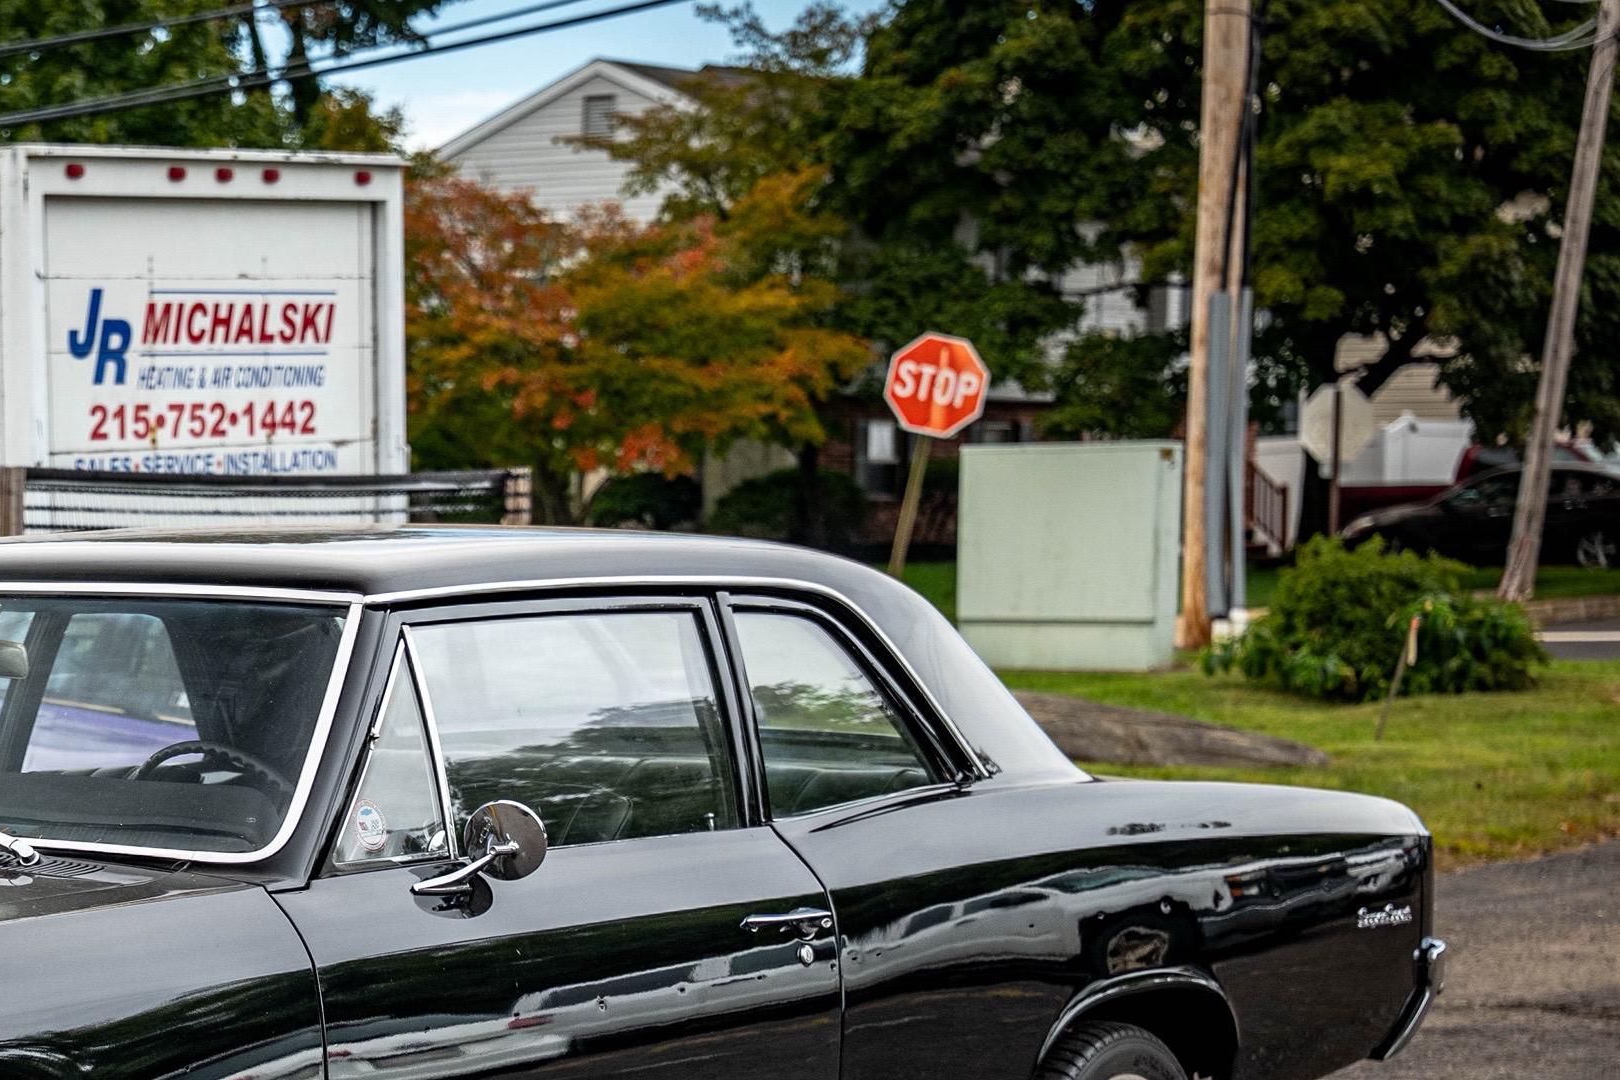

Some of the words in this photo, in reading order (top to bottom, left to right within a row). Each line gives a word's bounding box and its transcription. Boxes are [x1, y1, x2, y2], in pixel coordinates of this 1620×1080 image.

[142, 303, 336, 344] MICHALSKI
[138, 366, 194, 390] HEATING
[197, 366, 206, 389] &
[210, 365, 231, 388] AIR
[236, 364, 325, 387] CONDITIONING
[893, 360, 980, 409] STOP
